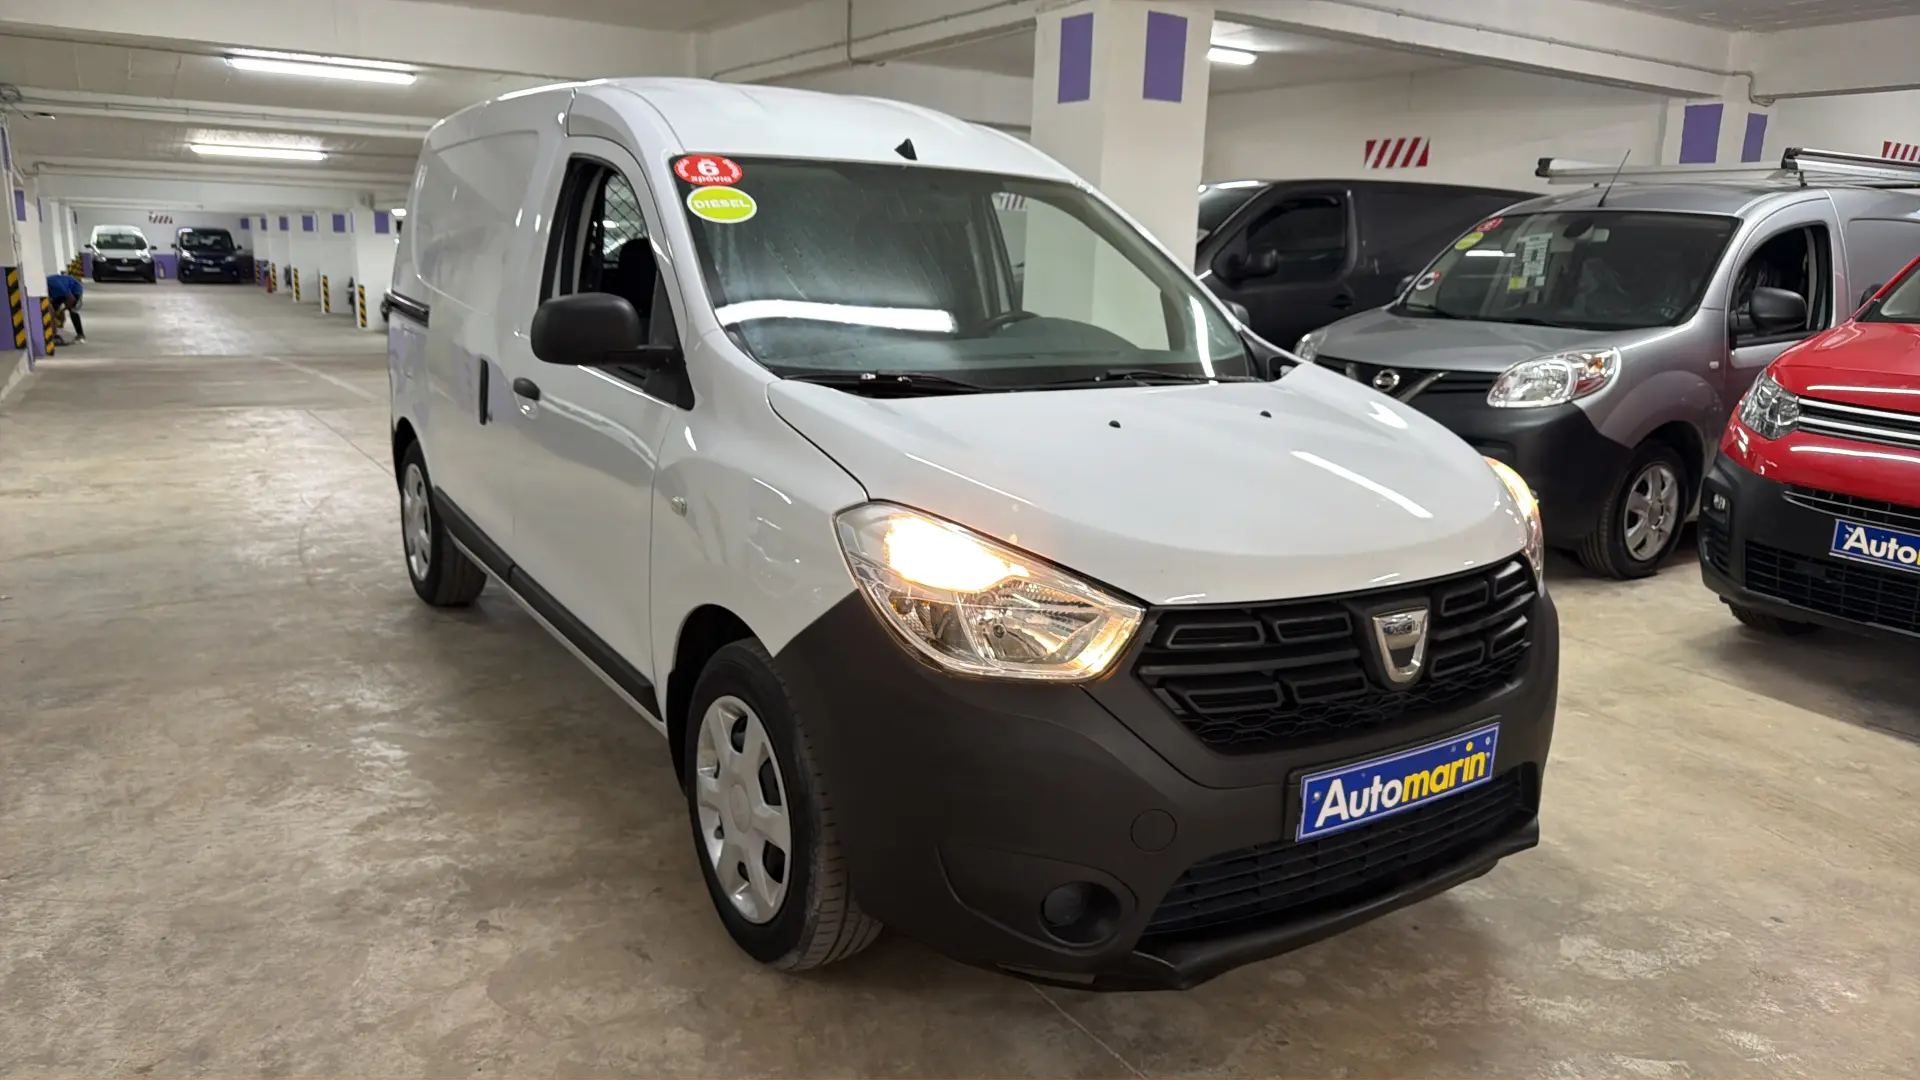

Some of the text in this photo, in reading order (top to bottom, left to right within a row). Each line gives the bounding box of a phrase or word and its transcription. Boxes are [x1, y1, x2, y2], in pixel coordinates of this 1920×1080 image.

[697, 158, 720, 176] 6
[693, 199, 751, 209] DIESEL
[1842, 526, 1920, 566] Auto
[1314, 741, 1487, 828] Automarin
